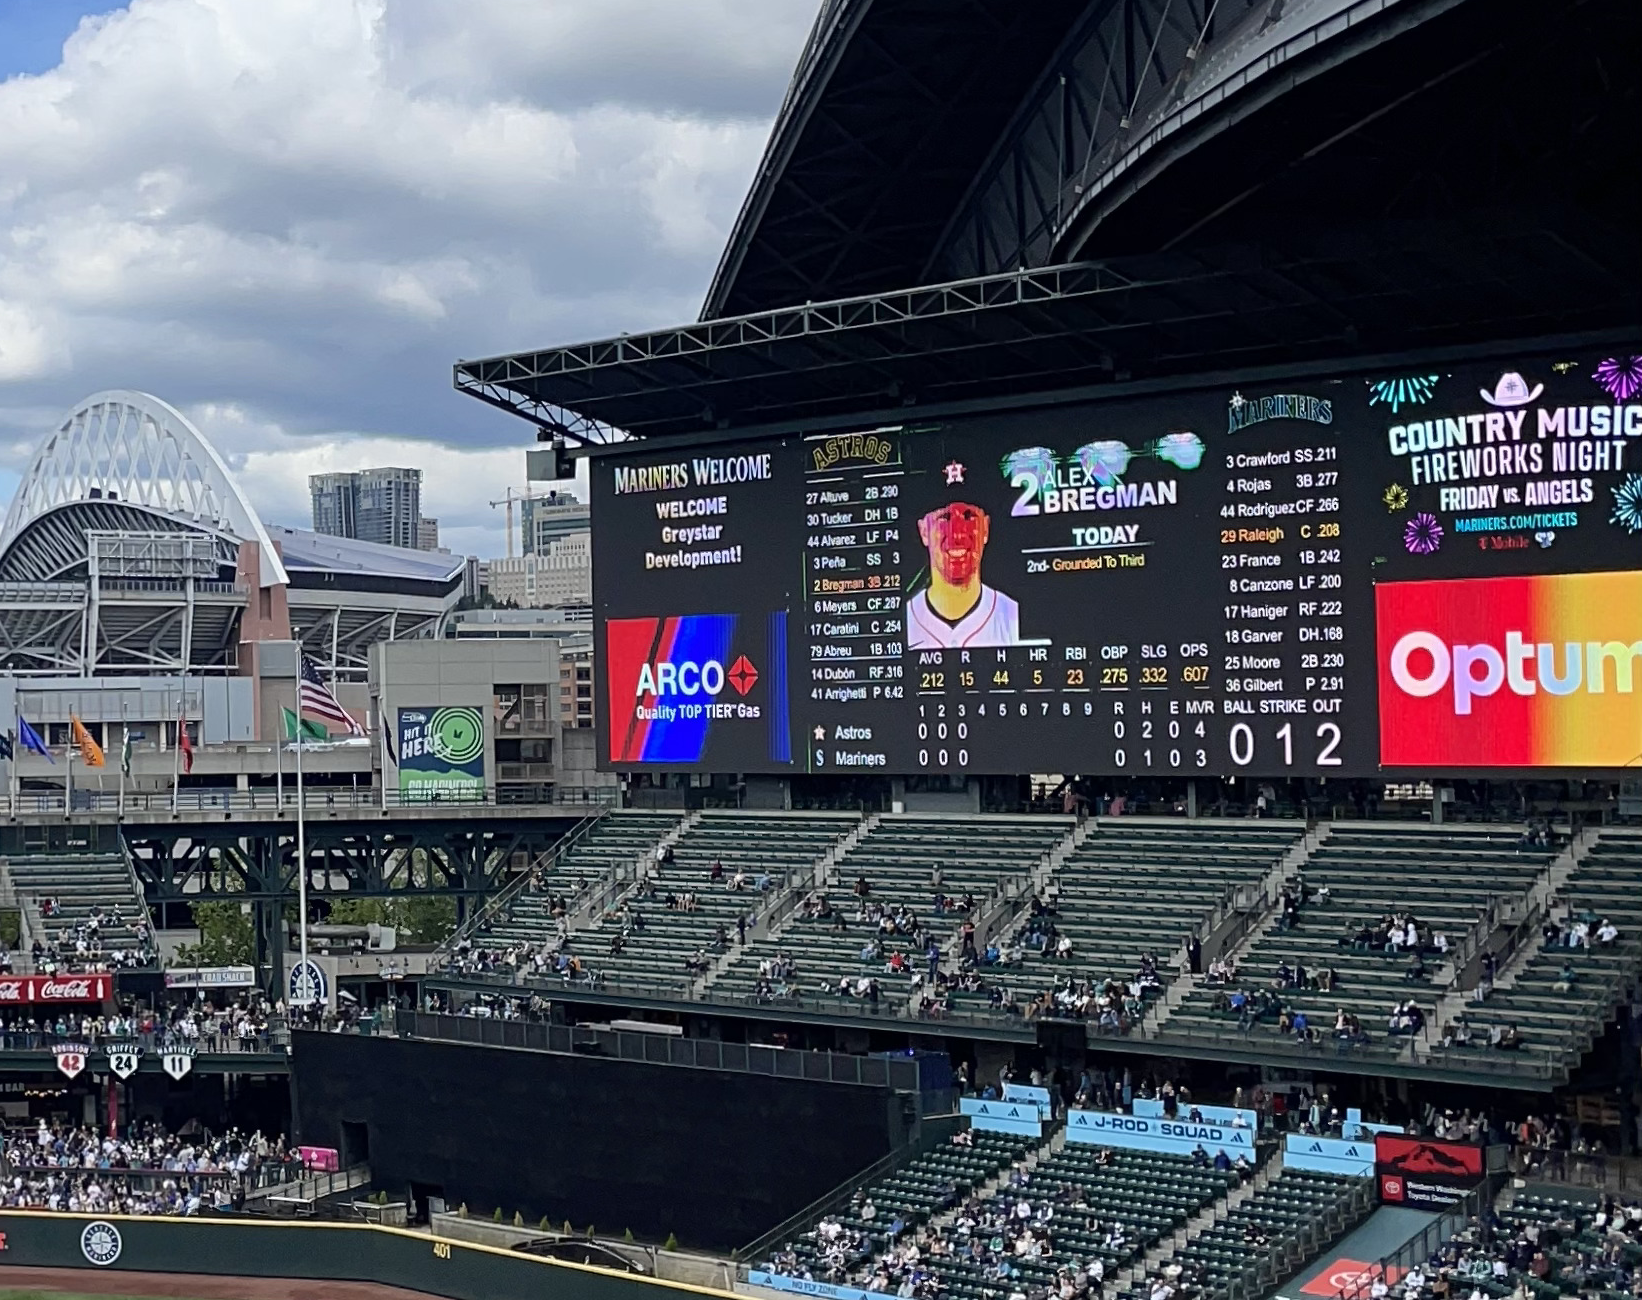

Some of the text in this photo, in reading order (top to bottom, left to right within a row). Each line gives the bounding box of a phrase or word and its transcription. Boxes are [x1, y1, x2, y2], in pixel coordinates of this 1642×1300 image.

[1227, 390, 1333, 435] MARINERS
[1388, 404, 1642, 457] COUNTRY MUSIC
[813, 434, 892, 471] ASTROS
[1226, 447, 1336, 468] 3 Crawford SS .211
[1411, 440, 1627, 486] FIREWORKS NIGHT
[614, 454, 772, 495] MARINERS WELCOME
[1043, 468, 1094, 488] ALEX
[1227, 472, 1338, 494] 4 Rojas 3B .277
[1011, 473, 1040, 517] 2
[1044, 480, 1177, 514] BREGMAN
[1439, 484, 1500, 512] FRIDAY
[1524, 478, 1593, 506] ANGELS
[656, 496, 727, 519] WELCOME
[1455, 511, 1578, 533] MARINERS.COM/TICKETS
[662, 524, 723, 545] Greystar
[1072, 525, 1139, 546] TODAY
[645, 545, 742, 570] Development!
[1052, 556, 1102, 571] Grounded
[1104, 556, 1117, 568] To
[1120, 554, 1145, 567] Third
[636, 660, 724, 697] ARCO
[1390, 631, 1642, 716] Optum
[636, 706, 676, 722] Quality
[679, 705, 702, 718] TOP
[738, 703, 761, 718] Gas
[1224, 699, 1342, 713] BALL STRIKE OUT
[404, 726, 420, 740] HIT
[1229, 722, 1342, 765] 0 1 2
[52, 1044, 89, 1054] ROBINSON
[106, 1044, 138, 1054] GRIFFEY
[156, 1045, 197, 1056] MARTINEZ
[61, 1055, 80, 1071] 42
[115, 1055, 133, 1071] 24
[171, 1056, 183, 1073] 11
[1095, 1117, 1222, 1141] J-ROD SQUAD
[792, 1280, 838, 1296] NO FLY ZONE
